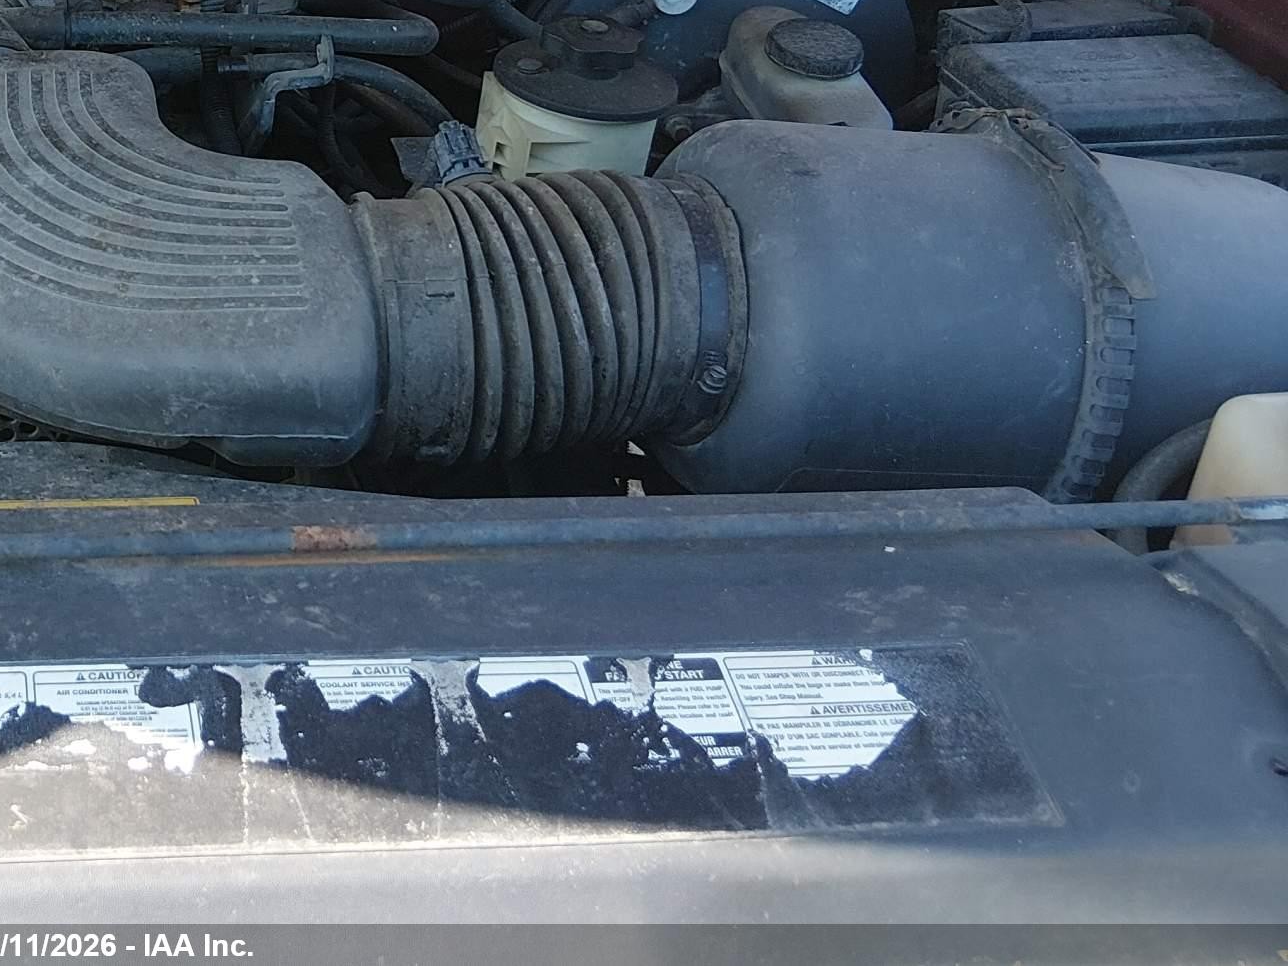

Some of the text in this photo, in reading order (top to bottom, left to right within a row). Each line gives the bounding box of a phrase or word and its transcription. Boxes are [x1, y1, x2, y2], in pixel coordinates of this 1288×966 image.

[363, 666, 410, 675] CAUTIO
[664, 669, 704, 680] START
[762, 671, 790, 679] TAMPER
[823, 669, 864, 678] DISCONNECT
[320, 681, 358, 689] COOLANT
[72, 687, 129, 695] CONDITIONER
[778, 693, 797, 701] Shop
[822, 702, 917, 715] AVERTISSEMEN
[767, 722, 780, 730] PAS
